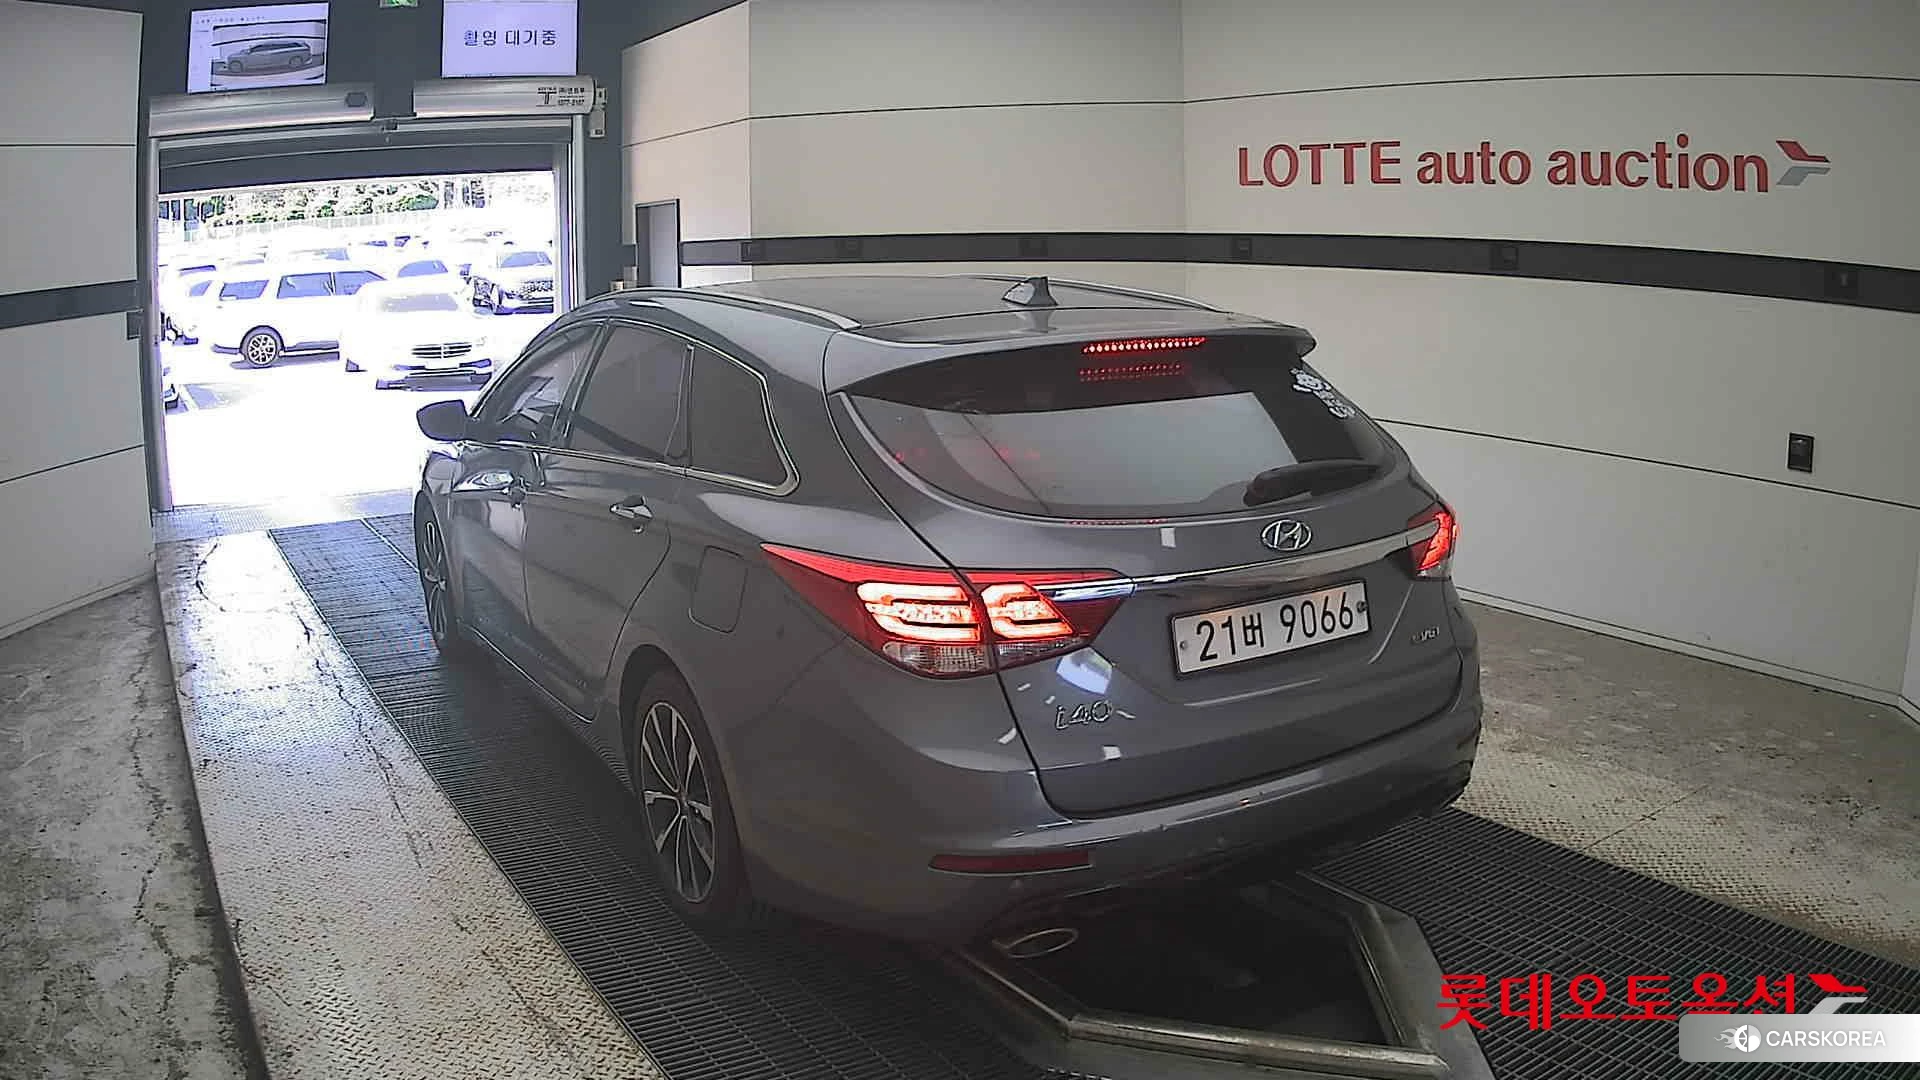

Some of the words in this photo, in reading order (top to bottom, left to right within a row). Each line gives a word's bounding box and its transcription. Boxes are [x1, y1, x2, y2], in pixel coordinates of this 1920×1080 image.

[505, 29, 557, 47] 대기중
[1238, 141, 1401, 187] LOTTE
[1417, 141, 1532, 185] auto
[1548, 133, 1769, 192] auction
[1196, 610, 1265, 662] 21버
[1279, 591, 1353, 644] 9066
